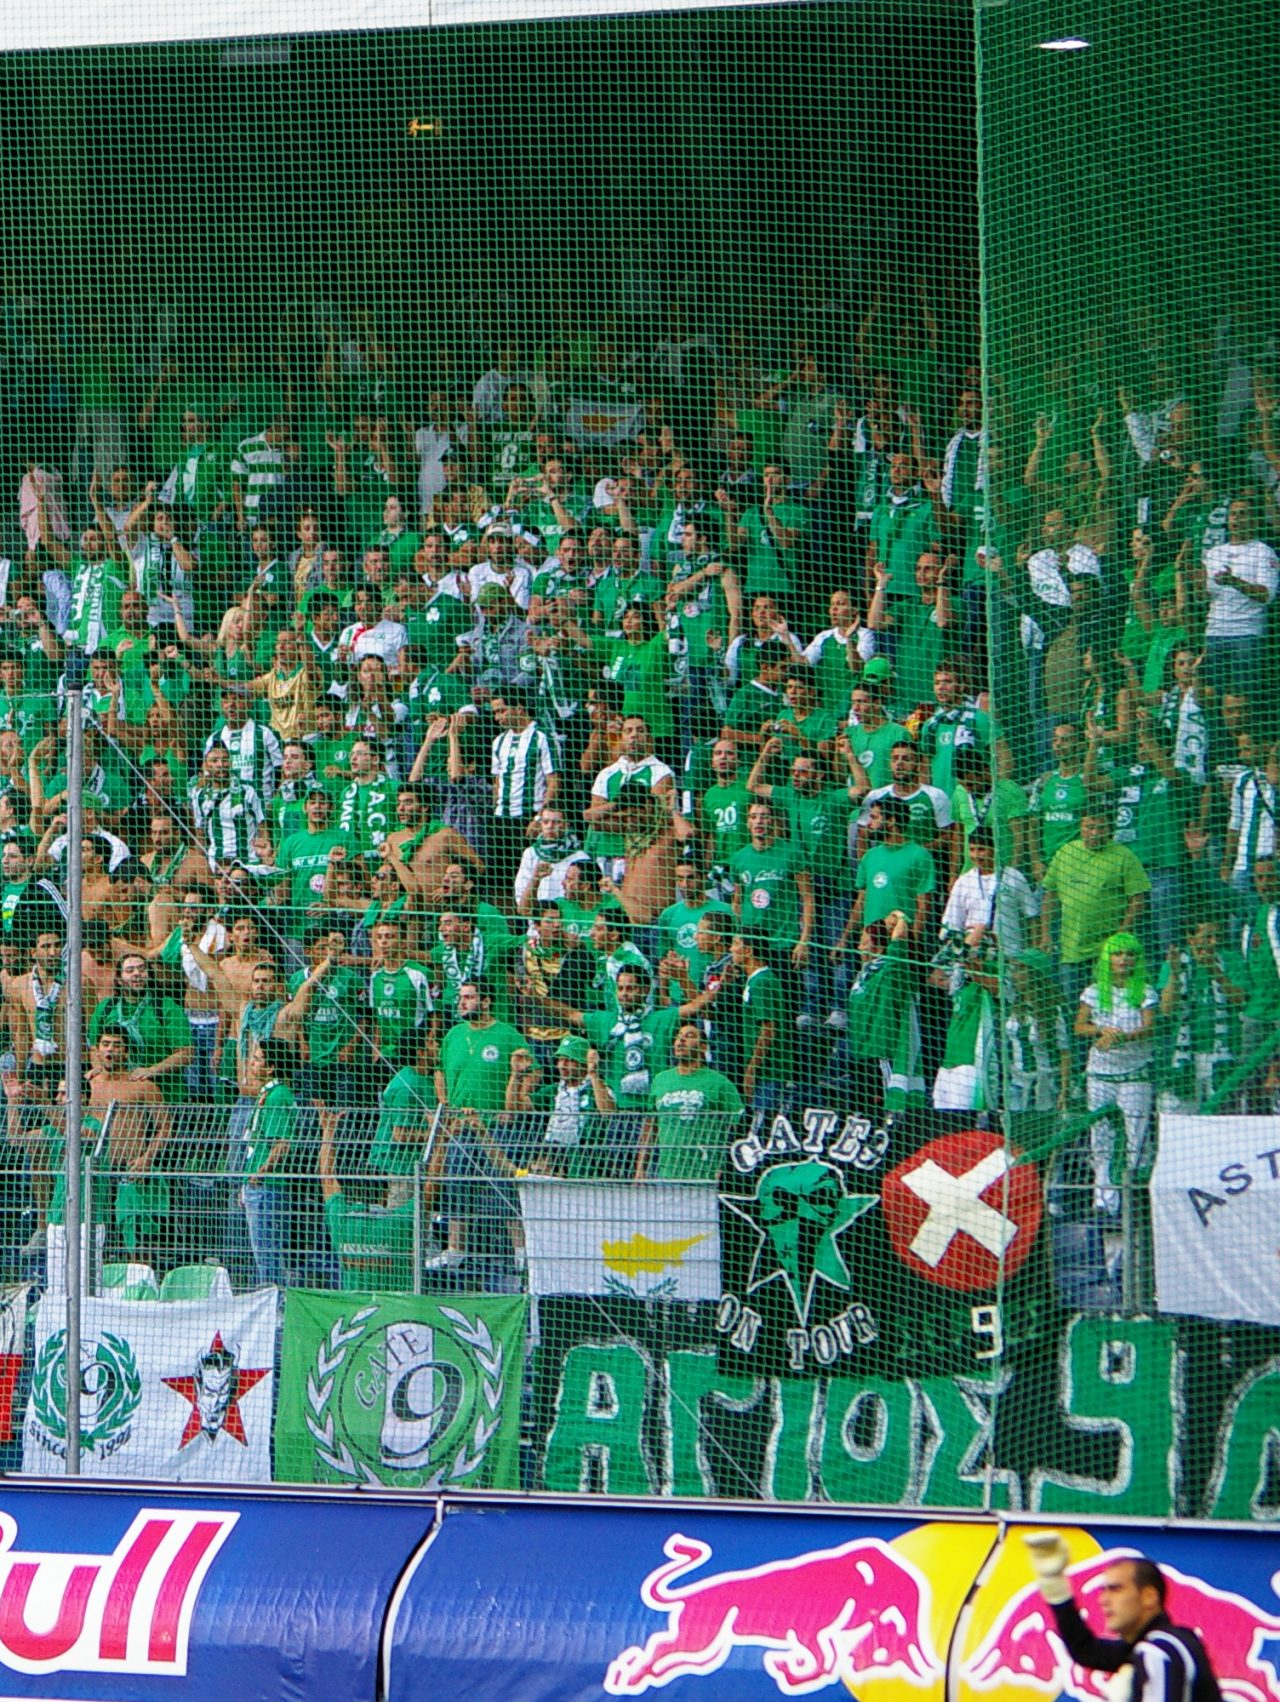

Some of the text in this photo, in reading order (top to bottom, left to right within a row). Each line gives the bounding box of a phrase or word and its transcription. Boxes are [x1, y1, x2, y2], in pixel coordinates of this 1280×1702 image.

[715, 1293, 878, 1370] ON TOUR
[971, 1304, 1004, 1360] 9
[381, 1360, 465, 1459] 9
